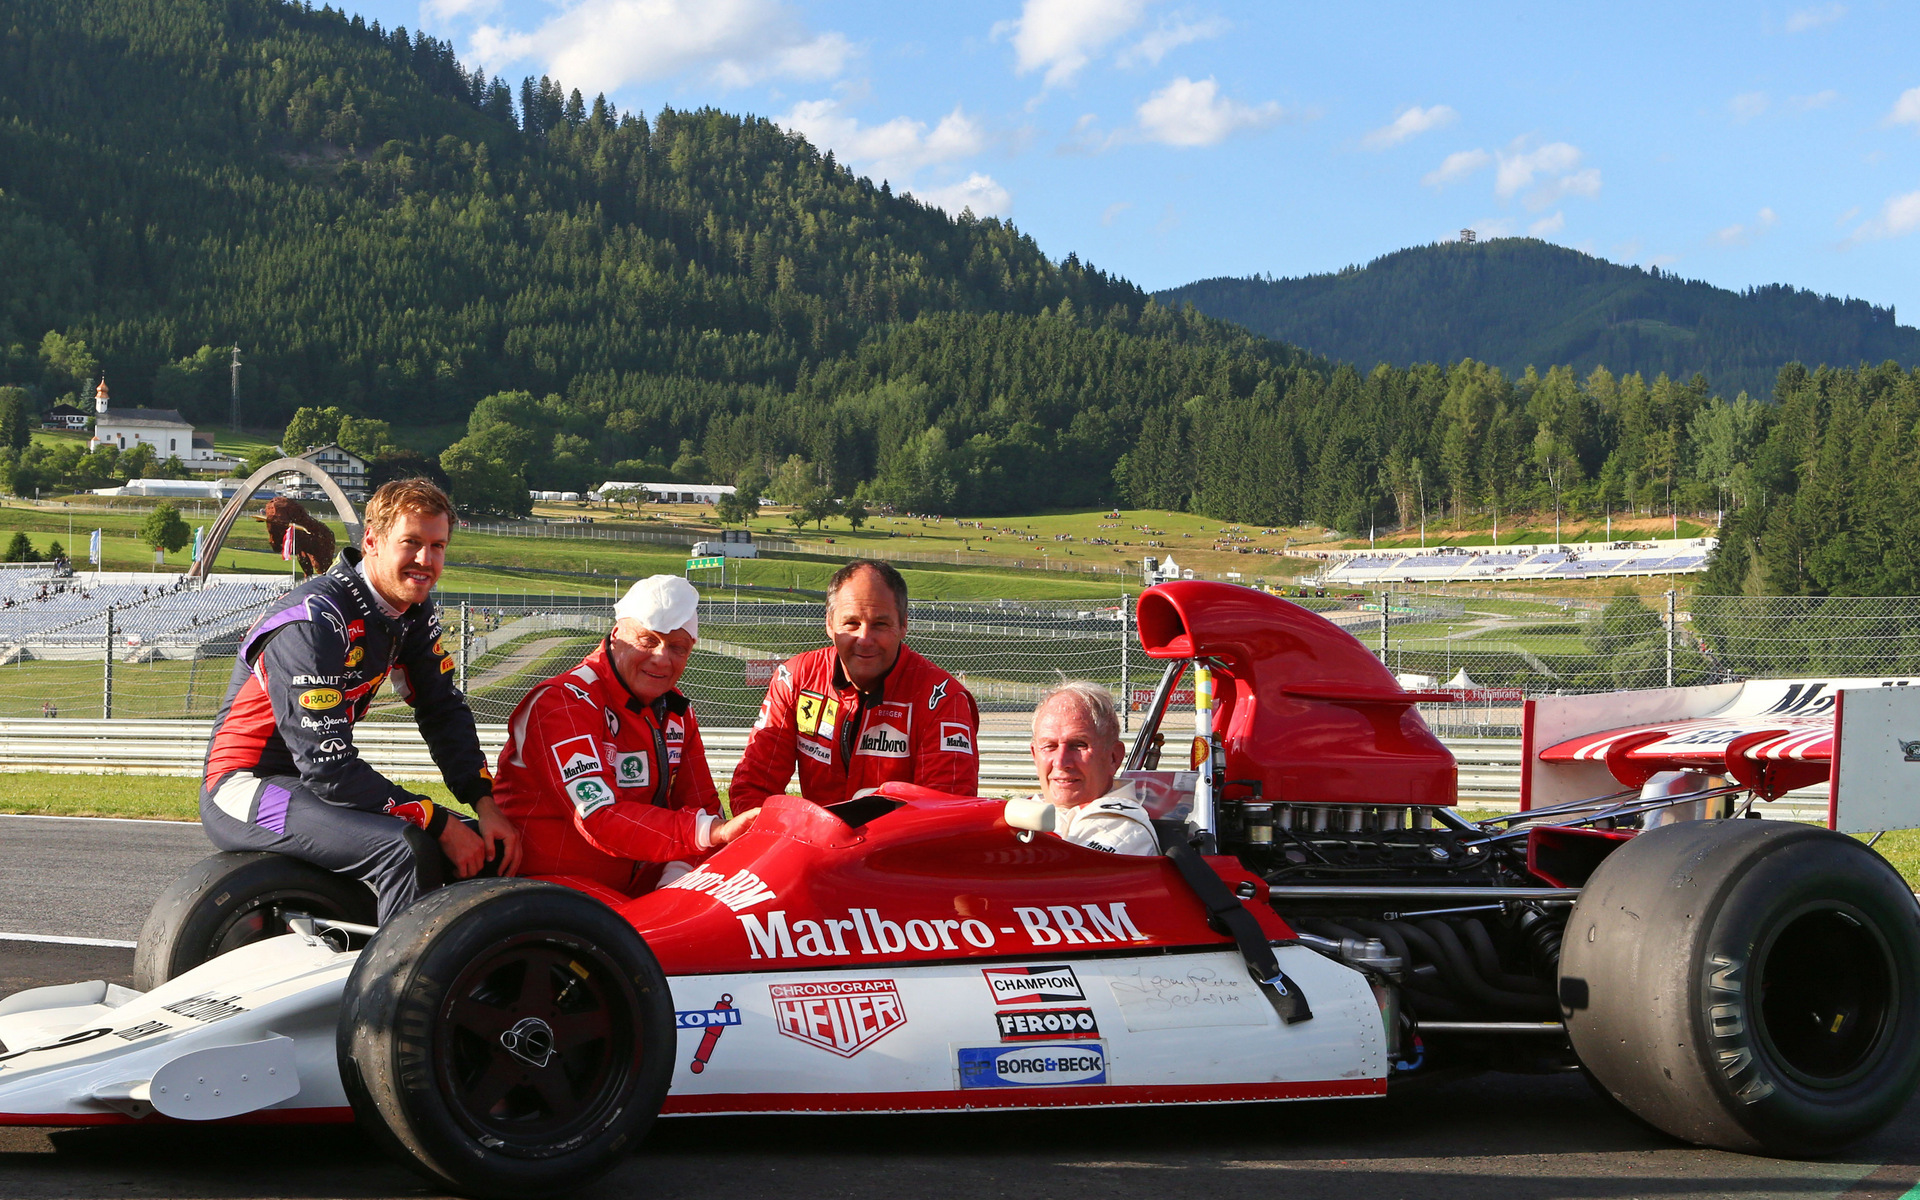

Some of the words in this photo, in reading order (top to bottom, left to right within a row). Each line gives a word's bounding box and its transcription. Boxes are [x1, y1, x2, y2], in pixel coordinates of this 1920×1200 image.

[331, 569, 371, 616] INFINITI
[293, 674, 340, 686] RENAULT
[310, 693, 338, 704] RAUCH
[860, 730, 907, 753] Marlboro
[563, 760, 599, 780] Marlboro
[771, 980, 895, 998] CHRONOGRAPH
[994, 976, 1075, 992] CHAMPION
[780, 1000, 899, 1053] HEUER
[1000, 1012, 1094, 1034] FERODO
[1708, 952, 1777, 1105] AVON
